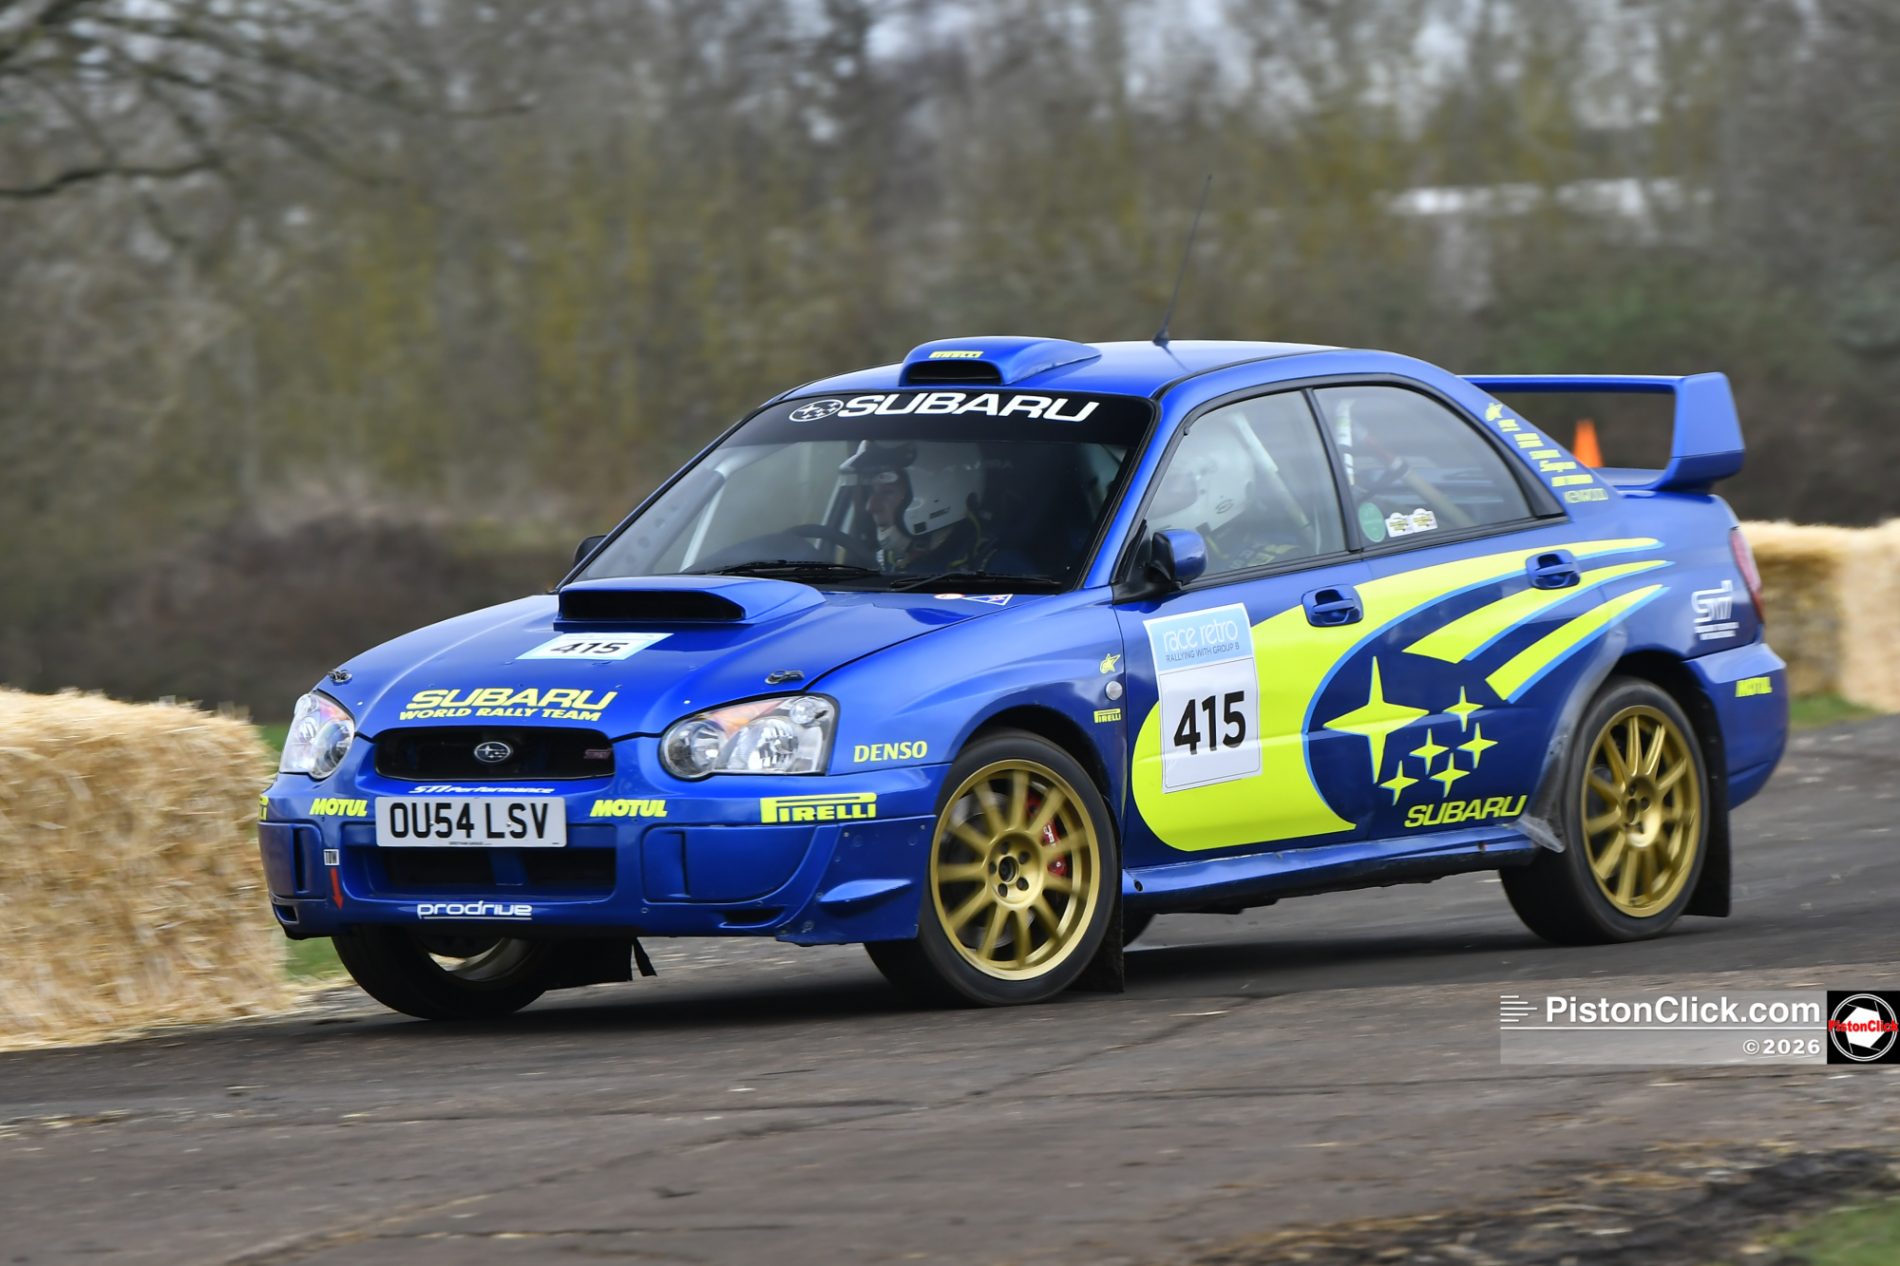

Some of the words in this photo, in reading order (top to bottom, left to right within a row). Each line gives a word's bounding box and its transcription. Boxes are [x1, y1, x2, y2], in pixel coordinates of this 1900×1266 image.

[838, 391, 1099, 422] SUBARU
[1163, 627, 1197, 652] race
[1200, 618, 1239, 645] retro
[550, 642, 629, 654] 415
[1166, 649, 1195, 662] RALLYING
[1196, 647, 1212, 657] WITH
[1213, 643, 1234, 654] GROUP
[406, 687, 618, 710] SUBARU
[399, 708, 472, 721] WORLD
[475, 707, 537, 718] RALLY
[542, 708, 602, 722] TEAM
[1094, 708, 1121, 723] PIRELLI
[1173, 690, 1246, 755] 415
[853, 740, 928, 763] DENSO
[309, 798, 368, 817] MOTUL
[589, 799, 668, 818] MOTUL
[759, 792, 877, 824] PIRELLI
[1403, 795, 1528, 828] SUBARU
[389, 802, 475, 839] OU54
[484, 802, 549, 839] LSV
[416, 900, 533, 920] prodrive
